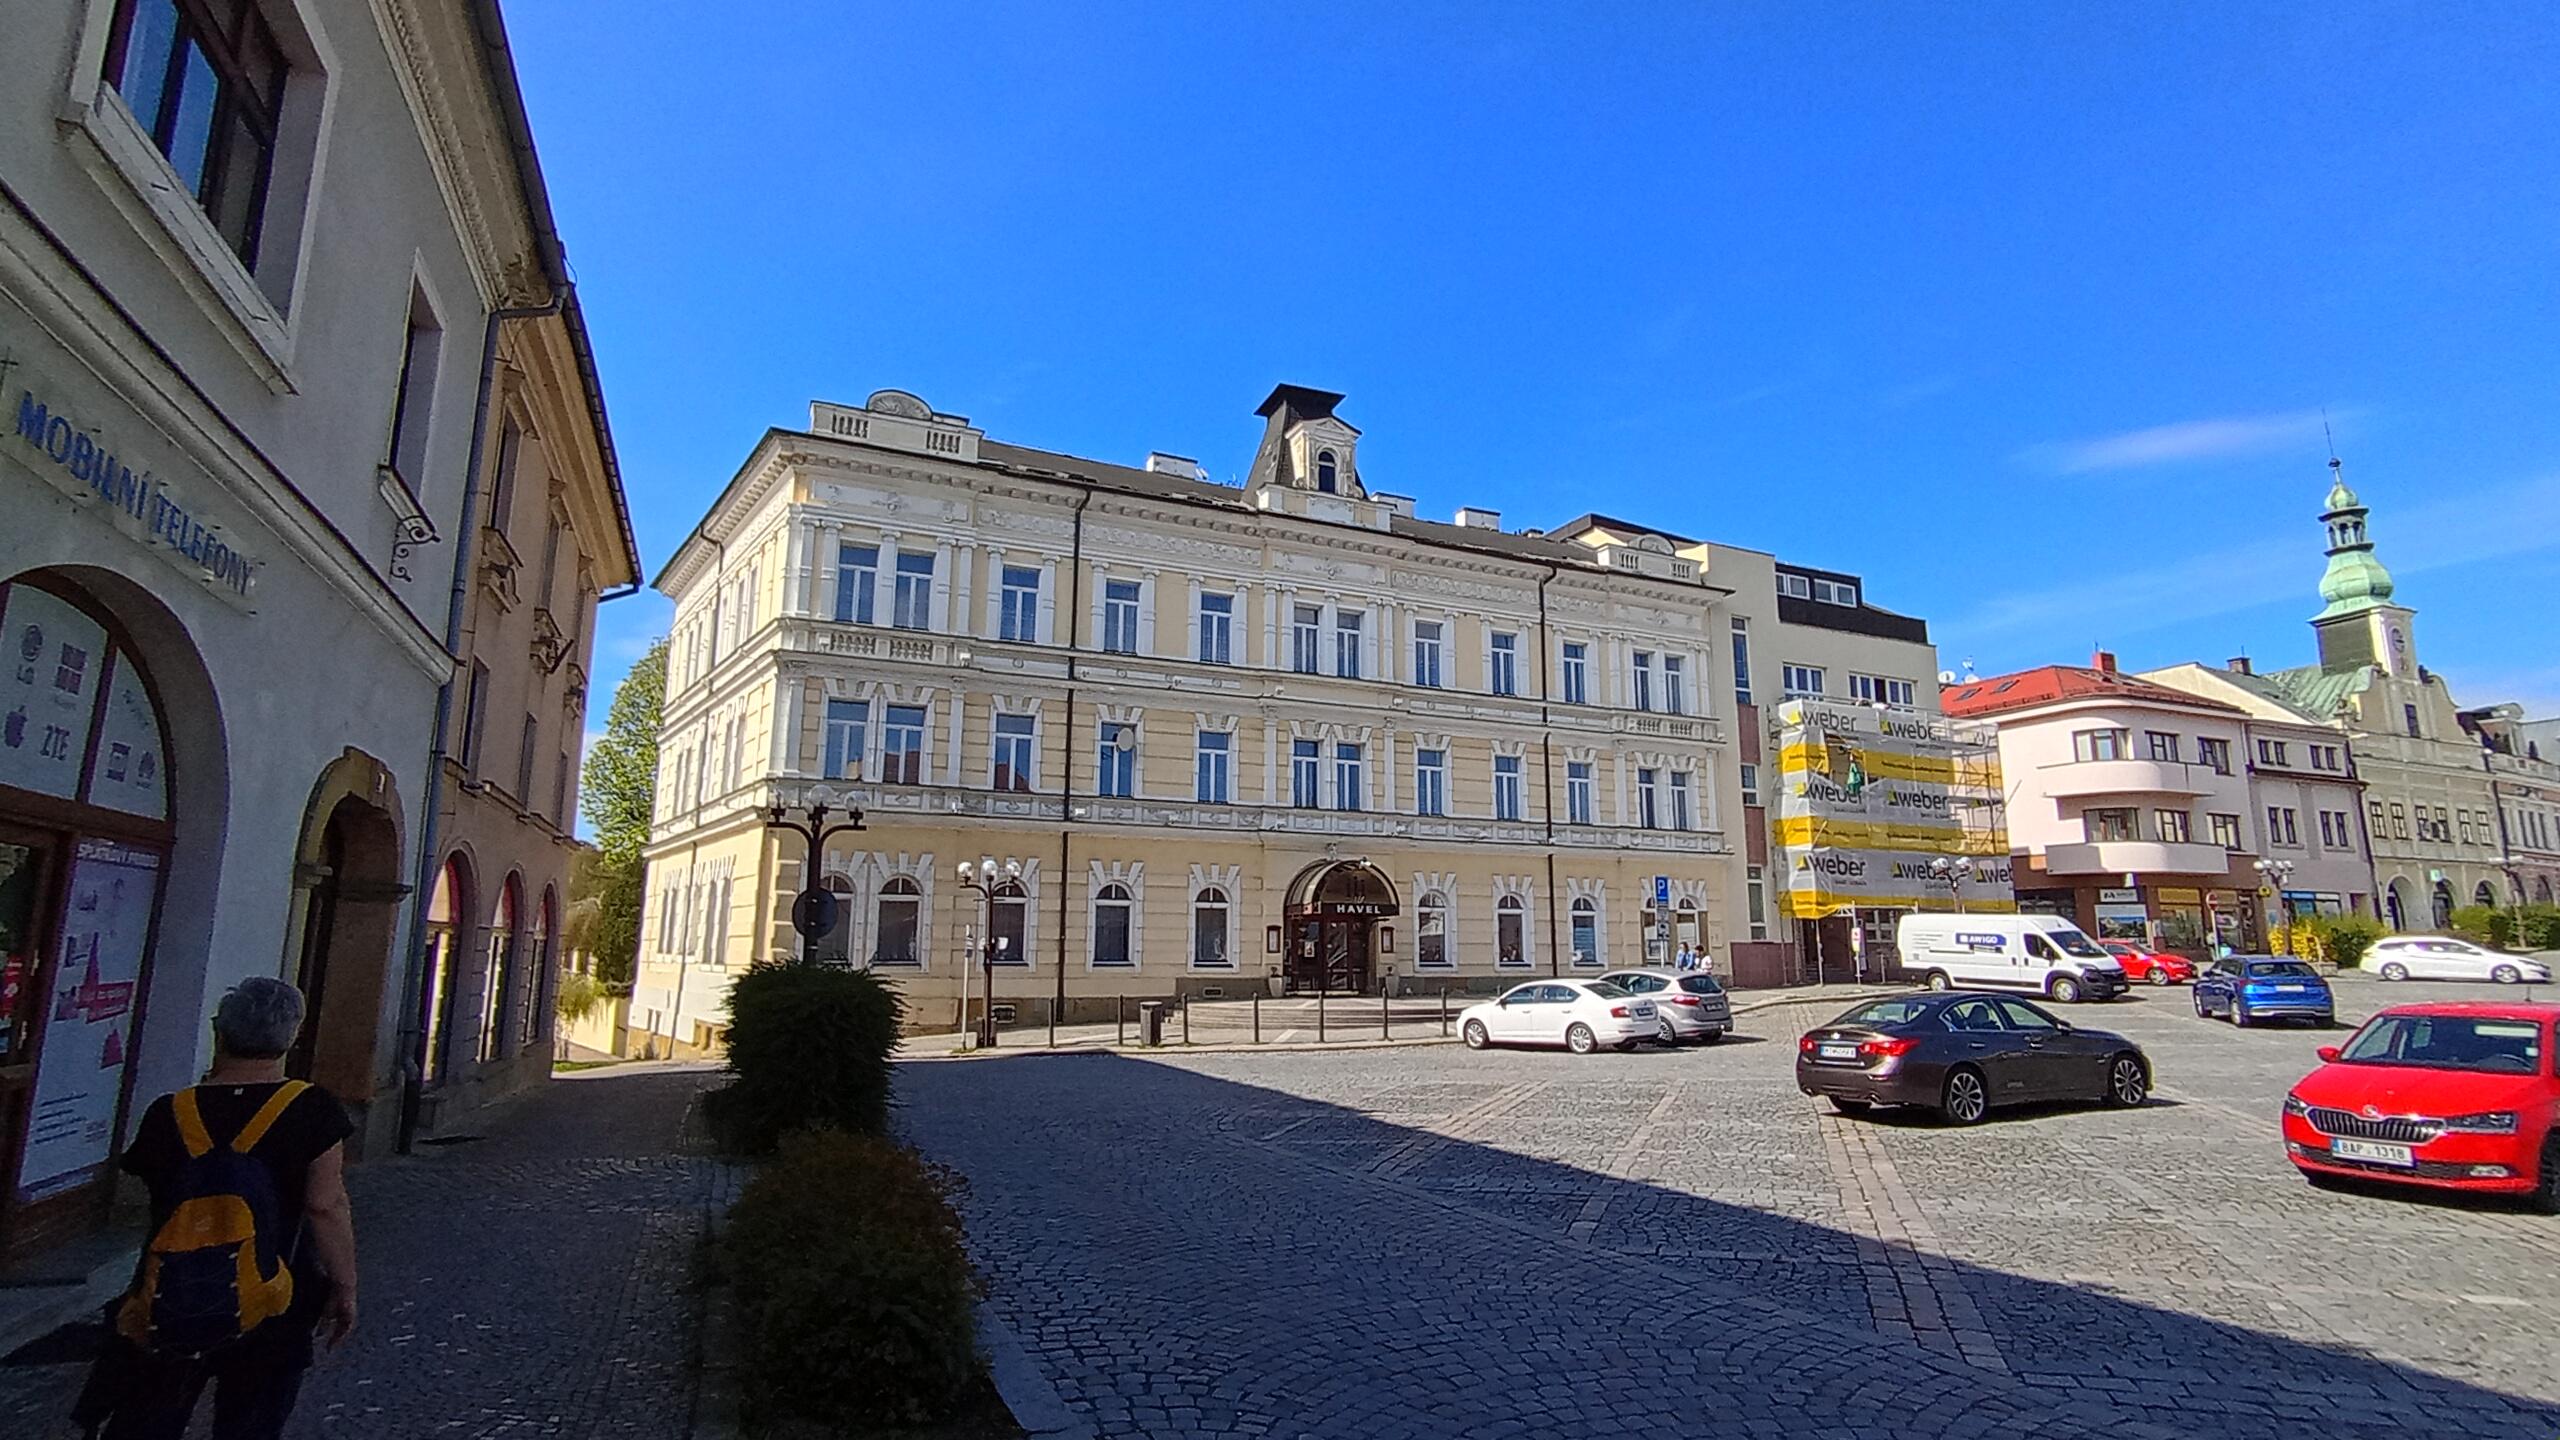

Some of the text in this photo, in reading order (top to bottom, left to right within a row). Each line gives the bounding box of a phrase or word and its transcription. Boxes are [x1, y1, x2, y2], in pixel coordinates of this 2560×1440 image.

[16, 389, 253, 597] MOBILNÍ TELEFONY
[1804, 708, 1857, 732] weber
[40, 723, 70, 761] ZTE
[1900, 789, 1948, 811] weber
[1809, 853, 1866, 877] weber
[1657, 879, 1666, 895] P
[1336, 904, 1381, 914] HAVEL
[2342, 1141, 2405, 1160] 8AP 1318
